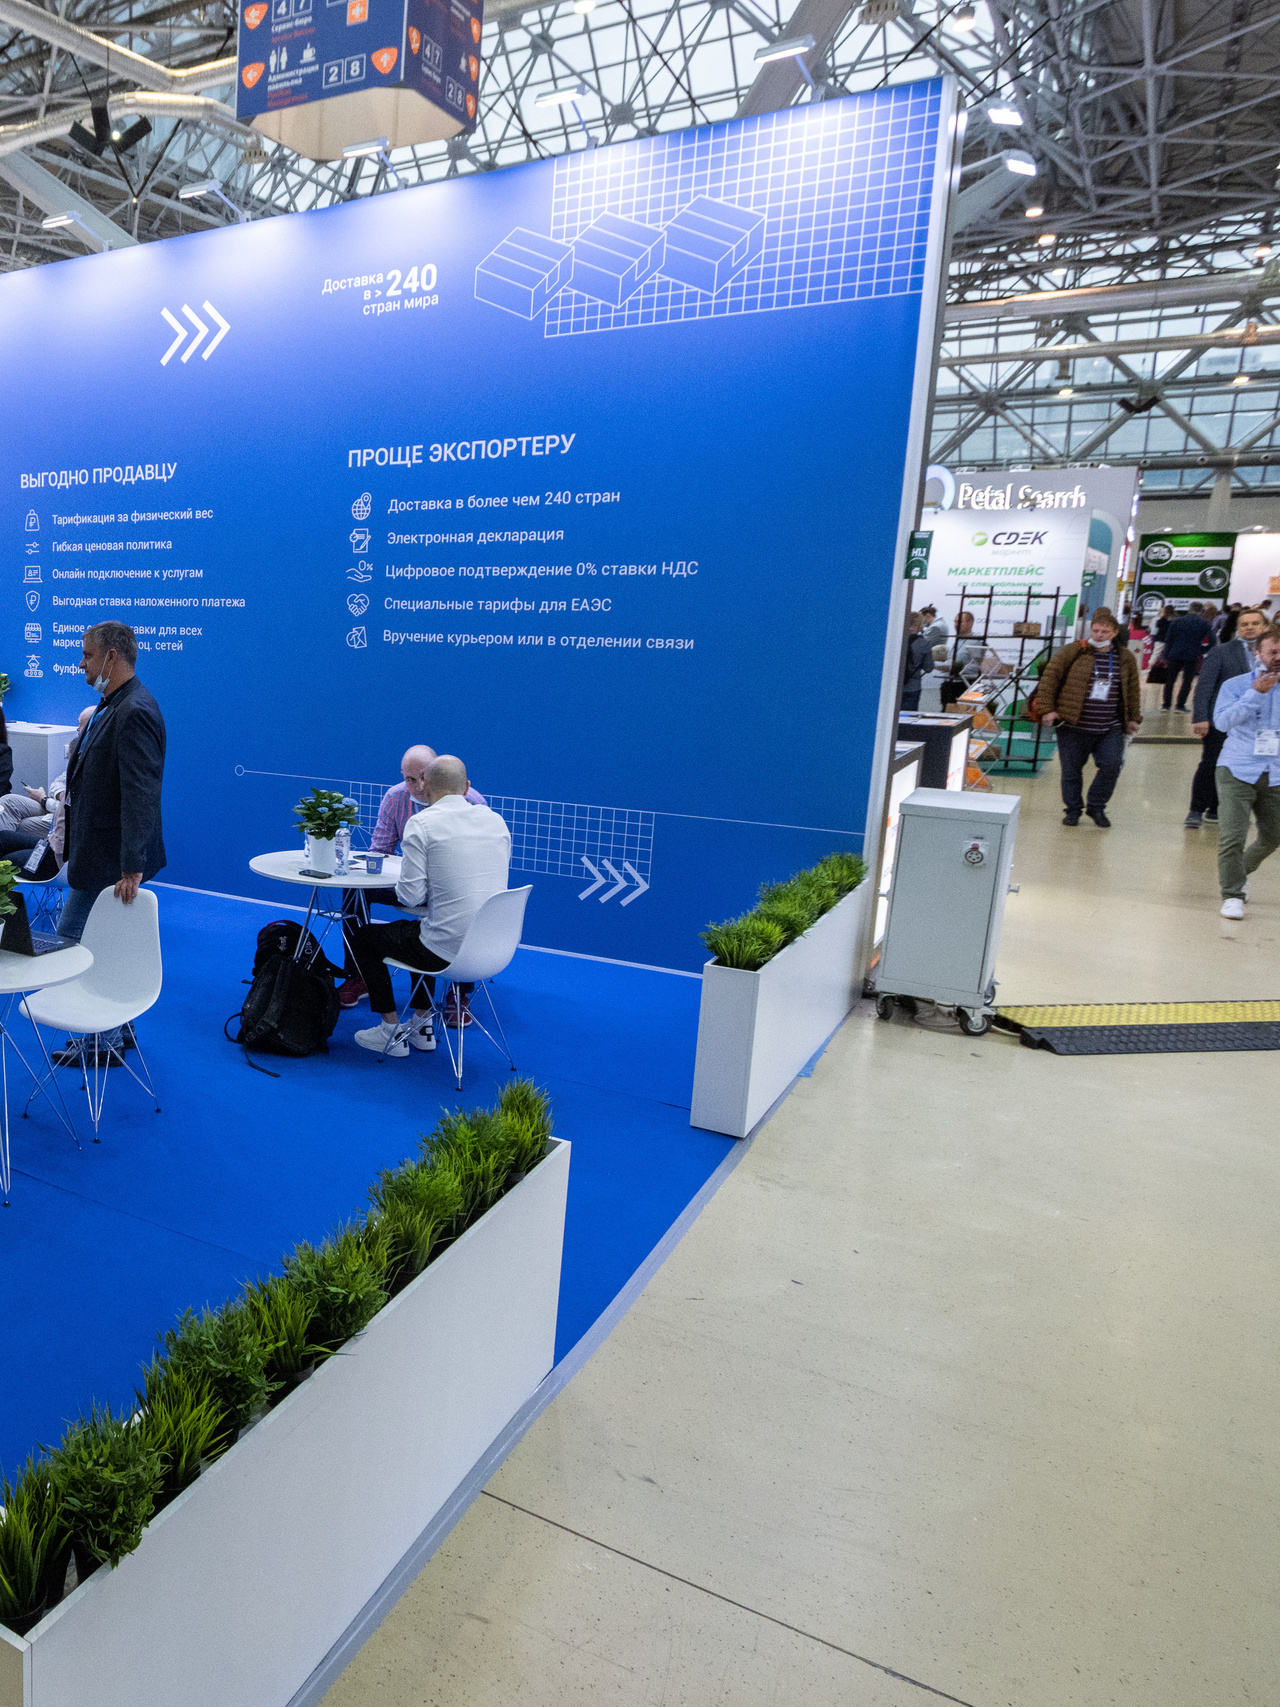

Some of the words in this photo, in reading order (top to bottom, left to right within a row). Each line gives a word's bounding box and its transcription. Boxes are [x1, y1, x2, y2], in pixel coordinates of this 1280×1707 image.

[328, 66, 339, 83] 2
[350, 60, 360, 77] 8
[321, 272, 384, 295] Доставка
[363, 290, 371, 300] в
[386, 263, 438, 297] 240
[362, 300, 401, 316] стран
[404, 294, 439, 310] мира
[348, 445, 424, 468] ПРОЩЕ
[429, 433, 576, 463] ЭКСПОРТЕРУ
[20, 469, 89, 490] ВЫГОДНО
[93, 462, 178, 486] ПРОДАВЦУ
[387, 497, 452, 514] Доставка
[455, 498, 464, 509] в
[468, 494, 509, 509] более
[512, 495, 541, 507] чем
[544, 491, 571, 505] 240
[575, 491, 621, 507] стран
[958, 482, 1013, 510] Petal
[52, 512, 115, 527] Тарификация
[117, 513, 129, 522] за
[131, 507, 193, 524] физический
[195, 508, 214, 519] вес
[52, 541, 83, 553] Гибкая
[85, 542, 124, 553] ценовая
[126, 540, 173, 551] политика
[387, 530, 474, 546] Электронная
[476, 530, 565, 545] декларация
[992, 530, 1049, 546] CDEK
[52, 568, 86, 580] Онлайн
[87, 568, 152, 581] подключение
[154, 568, 161, 578] к
[162, 567, 204, 581] услугам
[385, 564, 455, 580] Цифровое
[458, 565, 573, 579] подтверждение
[576, 562, 598, 576] 0%
[601, 564, 657, 575] ставки
[661, 561, 699, 578] НДС
[947, 564, 1045, 577] МАРКЕТПЛЕЙС
[52, 596, 98, 608] Выгодная
[99, 597, 132, 607] ставка
[133, 597, 199, 608] наложенного
[201, 597, 246, 608] платежа
[384, 597, 474, 612] Специальные
[477, 597, 535, 614] тарифы
[538, 600, 567, 614] для
[571, 598, 612, 612] ЕАЭС
[52, 622, 85, 634] Единое
[133, 625, 157, 635] авки
[158, 626, 178, 637] для
[179, 626, 203, 636] всех
[138, 641, 153, 652] оц.
[154, 640, 184, 651] сетей
[383, 629, 444, 645] Вручение
[447, 633, 514, 647] курьером
[517, 635, 544, 646] или
[547, 636, 556, 646] в
[560, 635, 642, 649] отделении
[646, 638, 695, 650] связи
